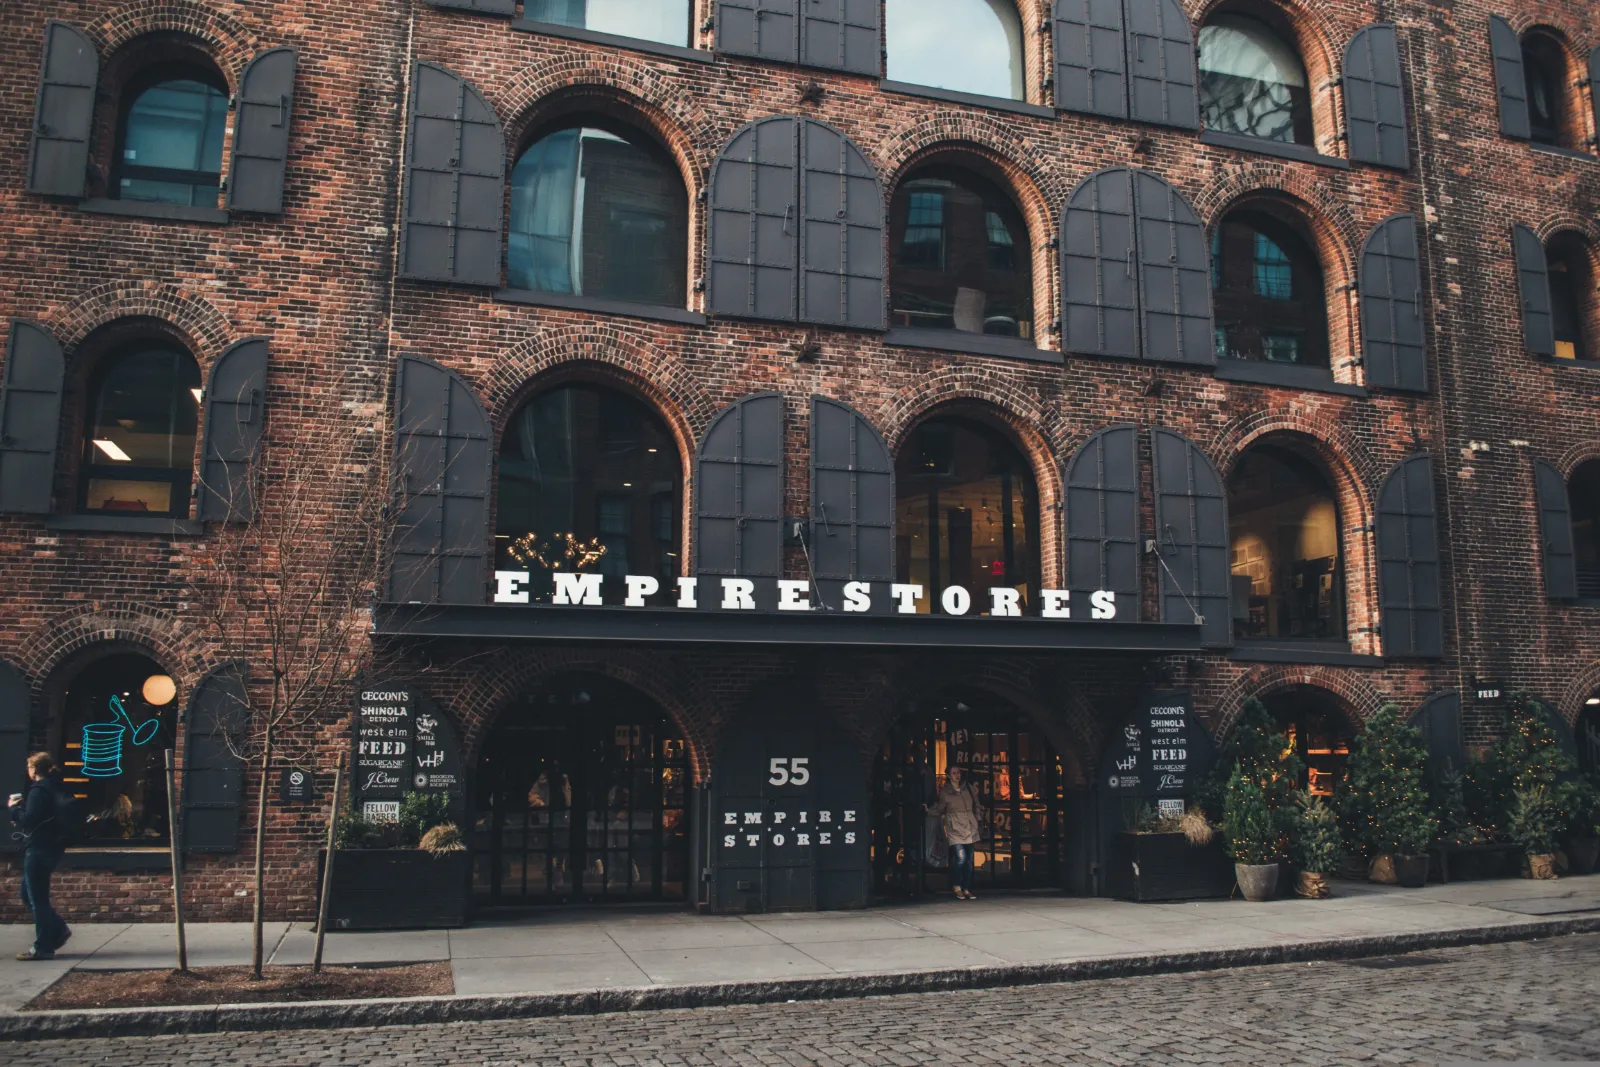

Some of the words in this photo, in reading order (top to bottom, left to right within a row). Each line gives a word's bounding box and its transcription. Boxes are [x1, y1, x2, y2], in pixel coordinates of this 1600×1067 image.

[494, 570, 809, 610] EMPIRE
[843, 581, 1116, 619] STORES
[361, 691, 409, 701] CECCONI'S
[1478, 689, 1499, 698] FEED
[360, 706, 408, 716] SHINOLA
[1150, 706, 1185, 715] CECCONI'S
[1150, 719, 1186, 728] SHINOLA
[359, 728, 384, 736] west
[388, 728, 408, 736] elm
[358, 741, 407, 755] FEED
[1152, 748, 1187, 760] FEED
[768, 757, 810, 786] 55
[366, 803, 397, 812] FELLOW
[724, 810, 856, 824] EMPIRE
[724, 832, 856, 847] STORES
